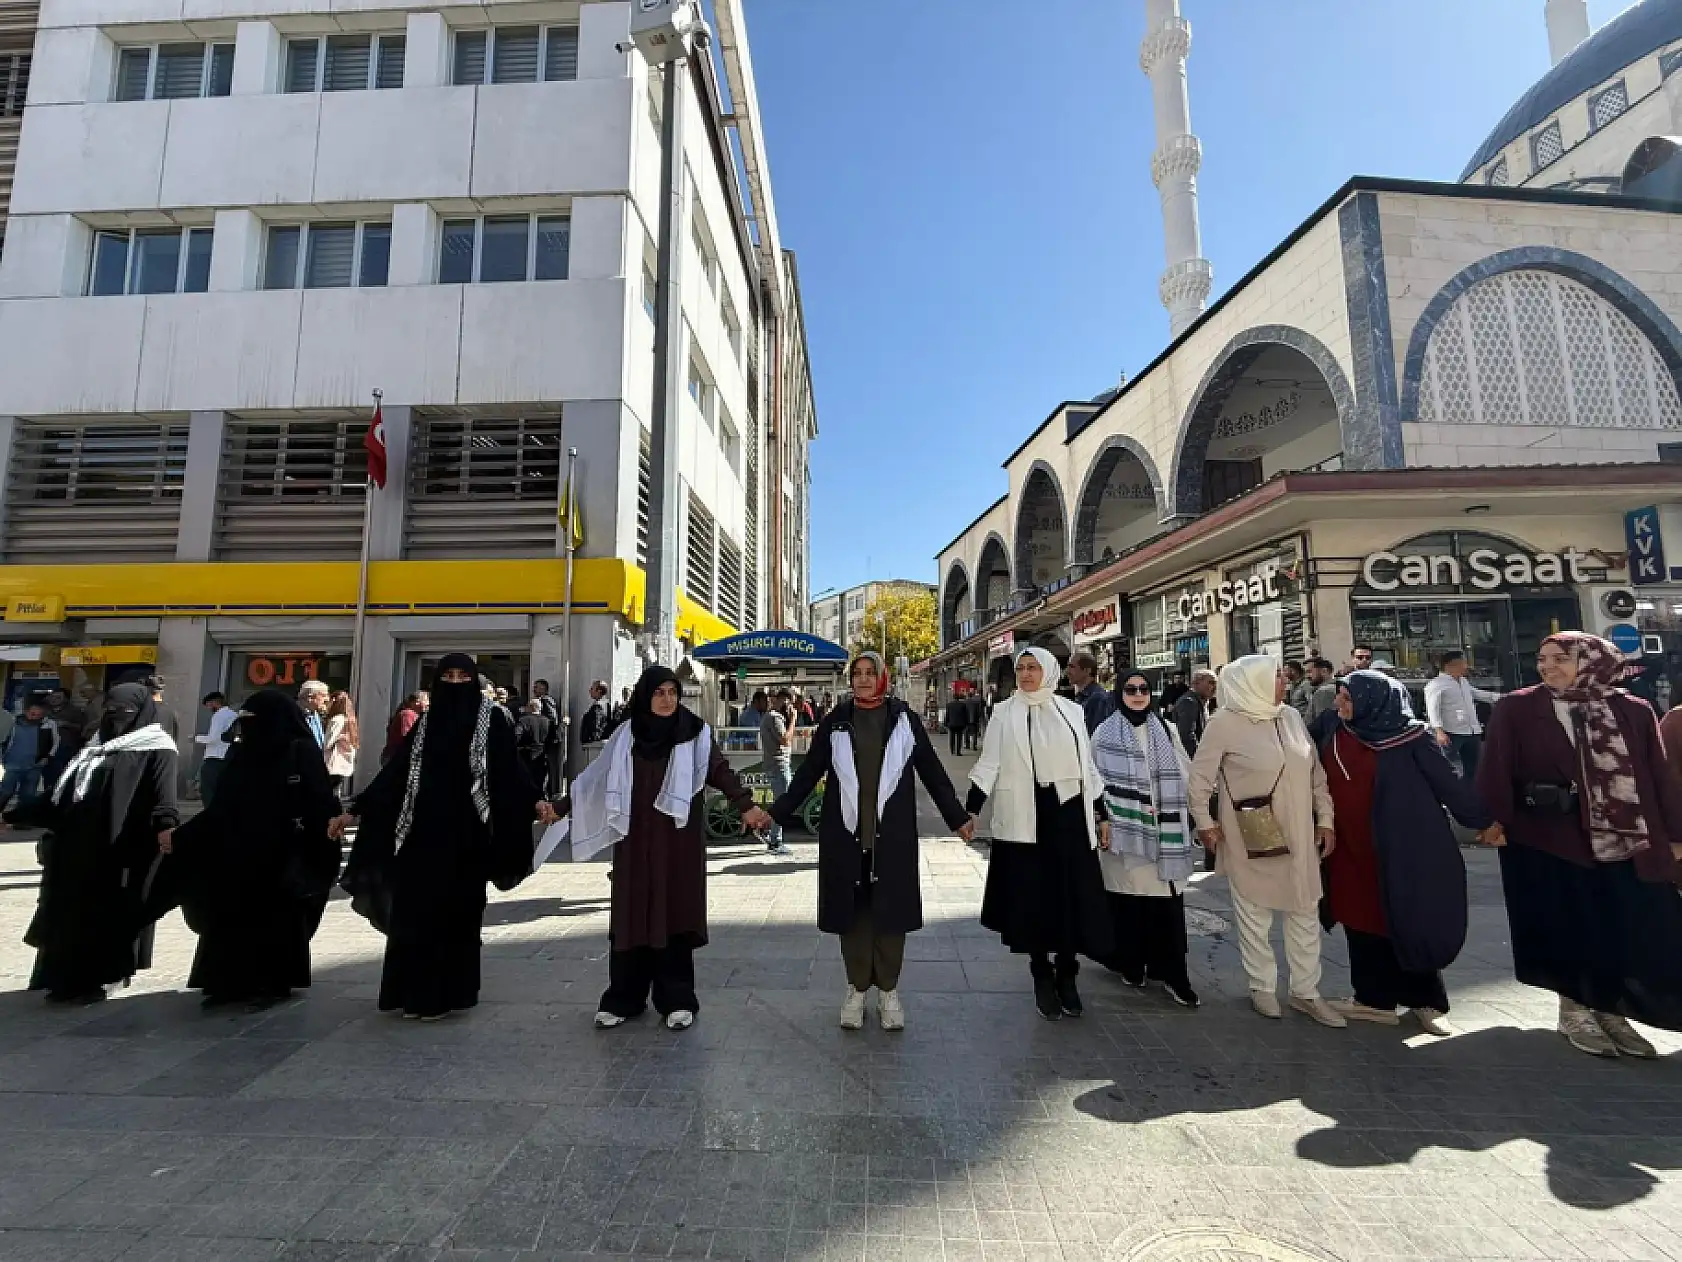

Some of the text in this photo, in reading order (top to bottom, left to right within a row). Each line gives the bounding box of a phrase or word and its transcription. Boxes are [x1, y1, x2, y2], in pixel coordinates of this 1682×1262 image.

[1363, 547, 1592, 591] Can Saat
[1633, 514, 1657, 577] KVK
[1179, 561, 1280, 620] Can Saat
[777, 636, 814, 654] AMCA
